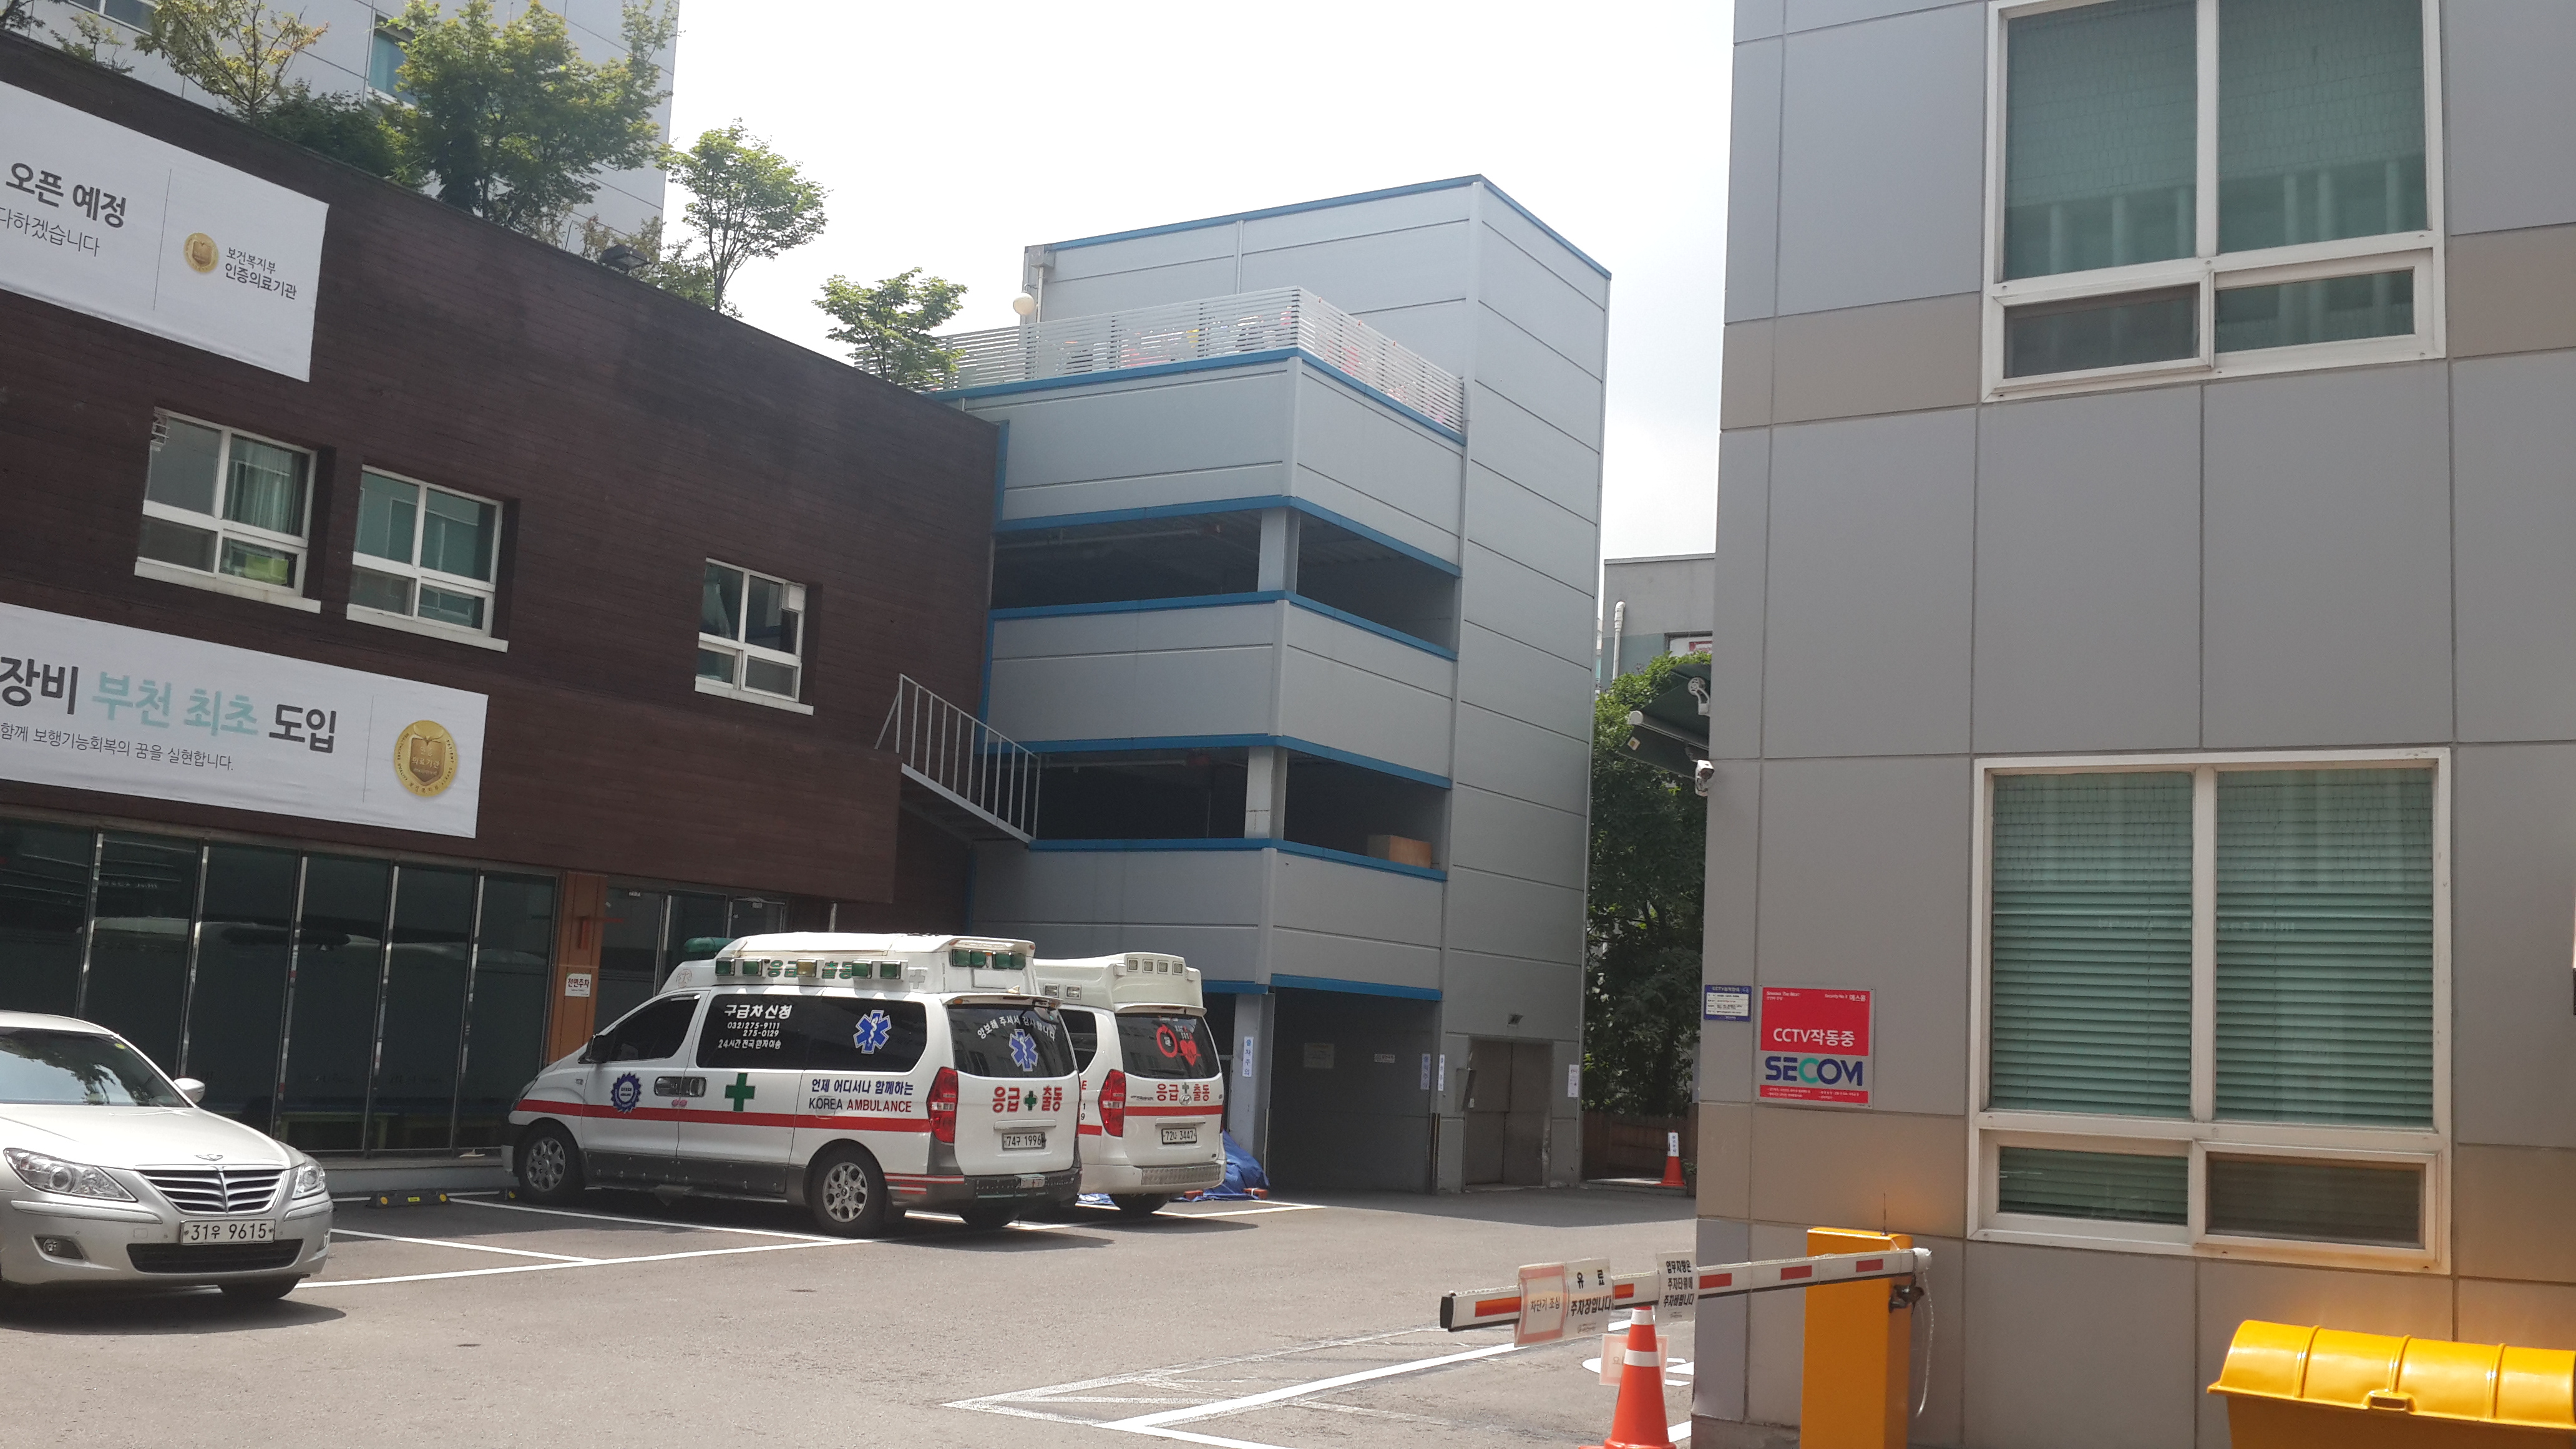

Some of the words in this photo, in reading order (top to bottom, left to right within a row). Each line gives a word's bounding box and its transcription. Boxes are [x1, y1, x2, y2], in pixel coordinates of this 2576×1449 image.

[6, 162, 64, 208] 오픈
[72, 183, 127, 228] 예정
[227, 247, 276, 275] 보건복지부
[225, 263, 297, 300] 인증의료기관
[0, 656, 79, 715] 장비
[92, 671, 172, 728] 부천
[183, 688, 259, 736] 최초
[268, 703, 337, 754] 도입
[1, 722, 29, 742] 함께
[33, 728, 130, 757] 보행기능회복의
[135, 742, 163, 761] 꿈을
[167, 748, 234, 771] 실현합니다.
[724, 1004, 763, 1019] 구급차
[765, 1005, 793, 1019] 신청
[743, 1029, 779, 1037] 275-0129
[1773, 1028, 1855, 1047] CCTV작동중
[1765, 1056, 1863, 1086] SECOM
[812, 1078, 830, 1093] 언제
[834, 1079, 871, 1093] 어디서나
[875, 1080, 914, 1095] 함께하는
[1156, 1083, 1179, 1101] 응급
[1193, 1083, 1210, 1101] 출동
[809, 1098, 842, 1110] KOREA
[846, 1099, 912, 1113] AMBULANCE
[992, 1086, 1020, 1113] 응급
[1042, 1085, 1063, 1112] 출동
[1024, 1134, 1042, 1146] 1996
[1179, 1130, 1193, 1140] 3447
[190, 1223, 221, 1239] 31우
[228, 1222, 268, 1239] 9615
[1571, 1294, 1612, 1317] 주차장입니다
